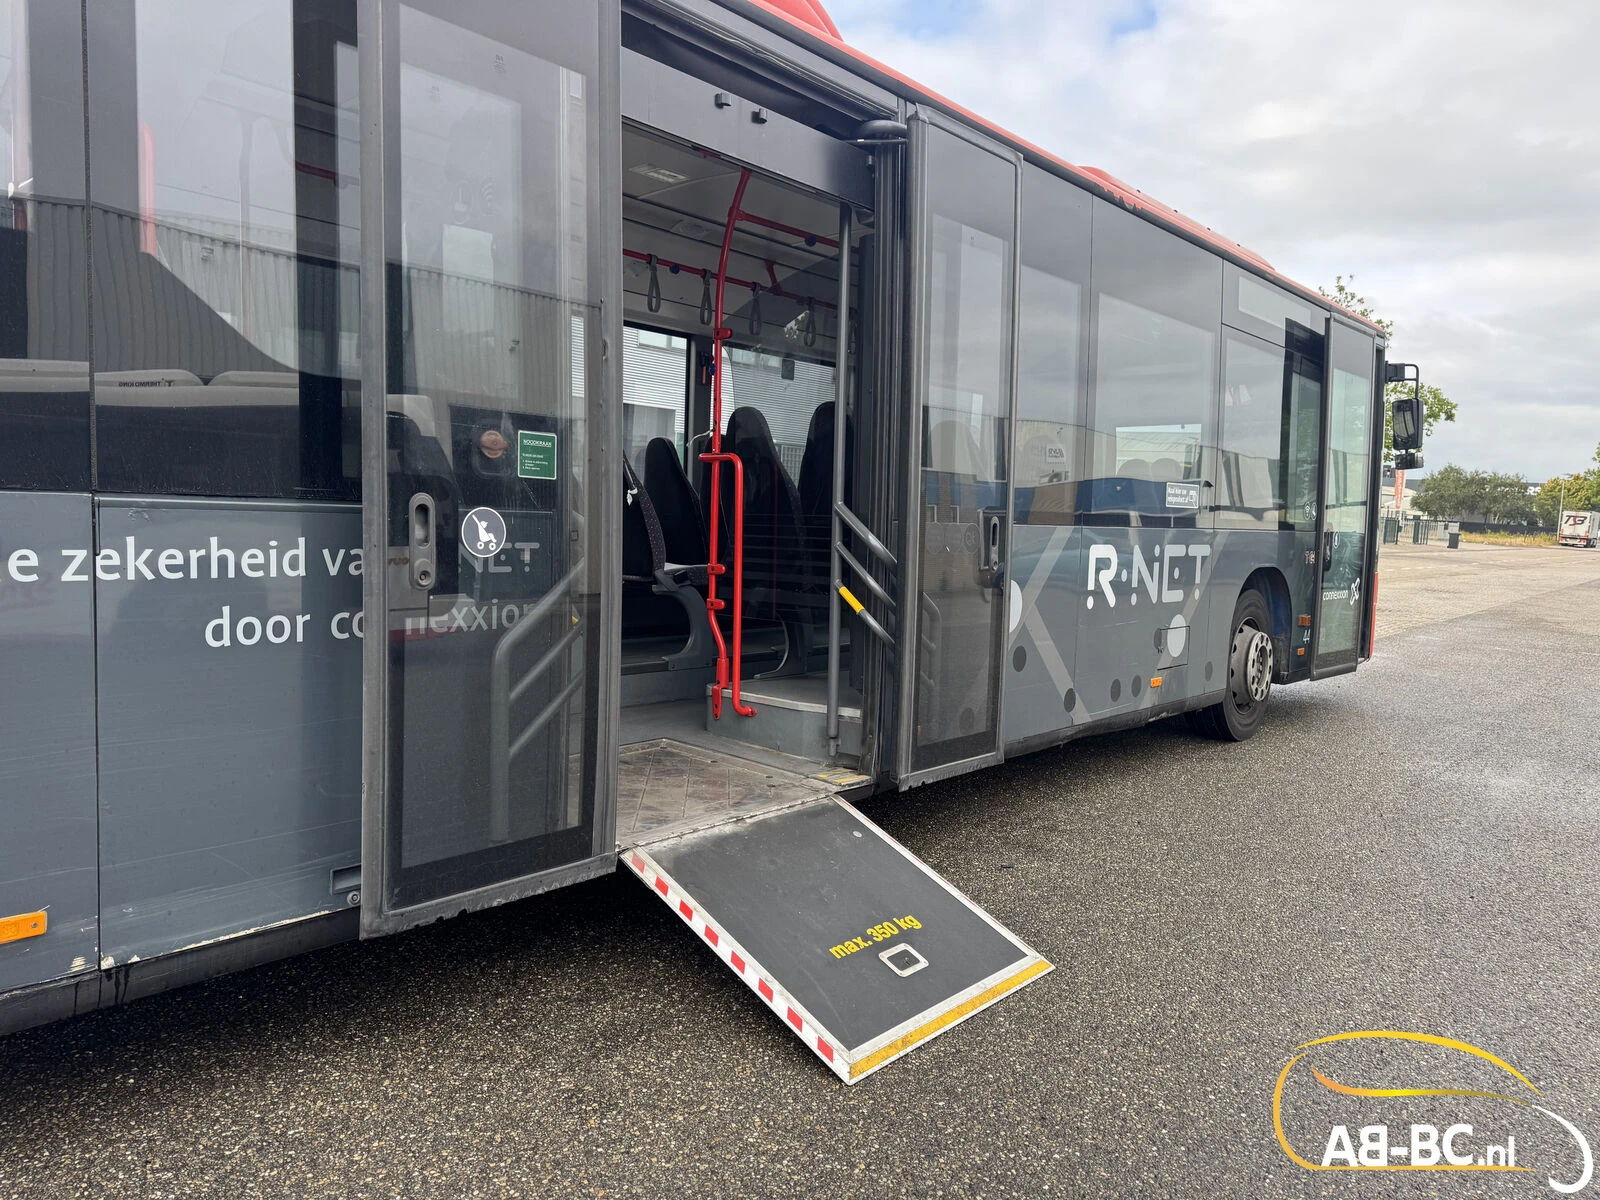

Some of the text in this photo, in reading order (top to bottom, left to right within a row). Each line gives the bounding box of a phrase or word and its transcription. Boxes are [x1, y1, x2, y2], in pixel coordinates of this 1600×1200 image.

[0, 535, 364, 583] e zekerheid va
[204, 605, 311, 648] door
[829, 915, 922, 959] max. 350 kg
